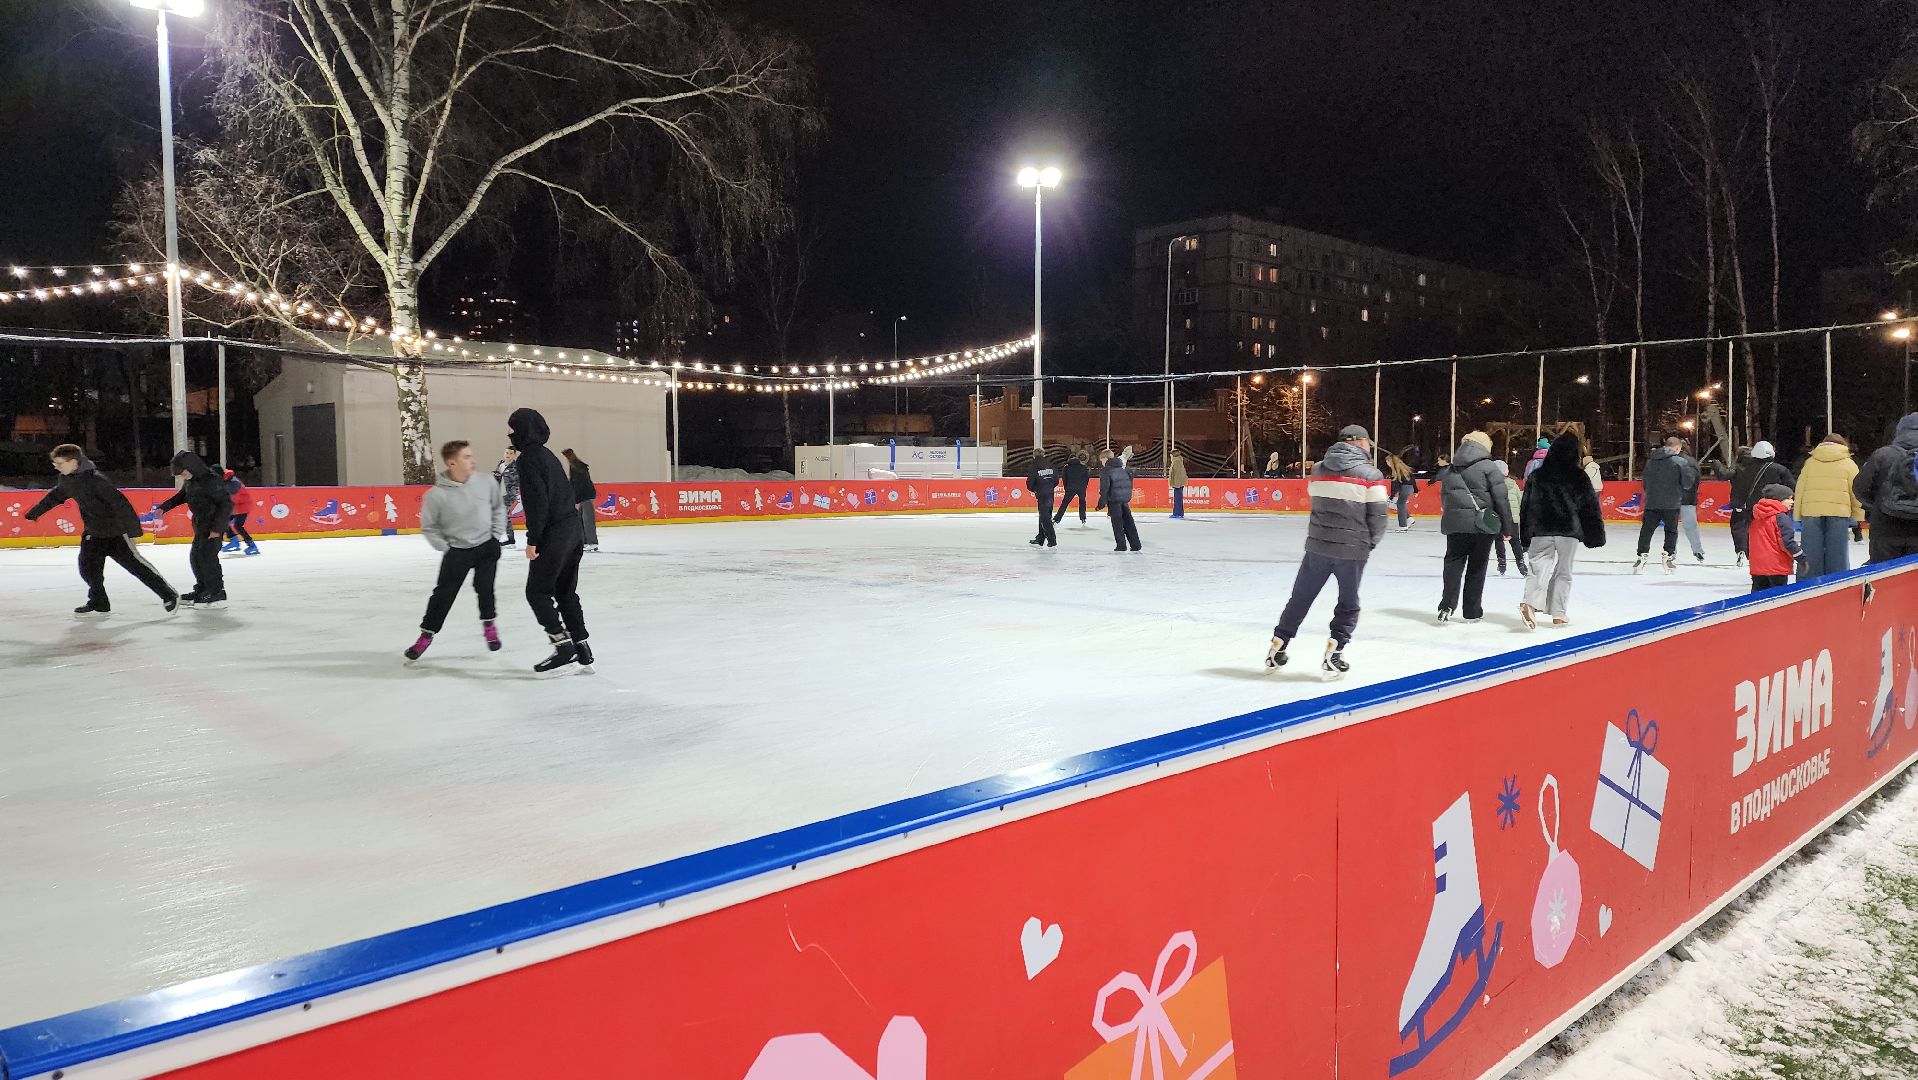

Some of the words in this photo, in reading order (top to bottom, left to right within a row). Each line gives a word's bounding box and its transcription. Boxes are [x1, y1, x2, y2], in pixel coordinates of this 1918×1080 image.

[678, 489, 722, 504] ЗИМА
[1733, 648, 1834, 778] ЗИМА
[1730, 800, 1742, 836] В
[1742, 747, 1832, 828] ПОДМОСКОВЬЕ
